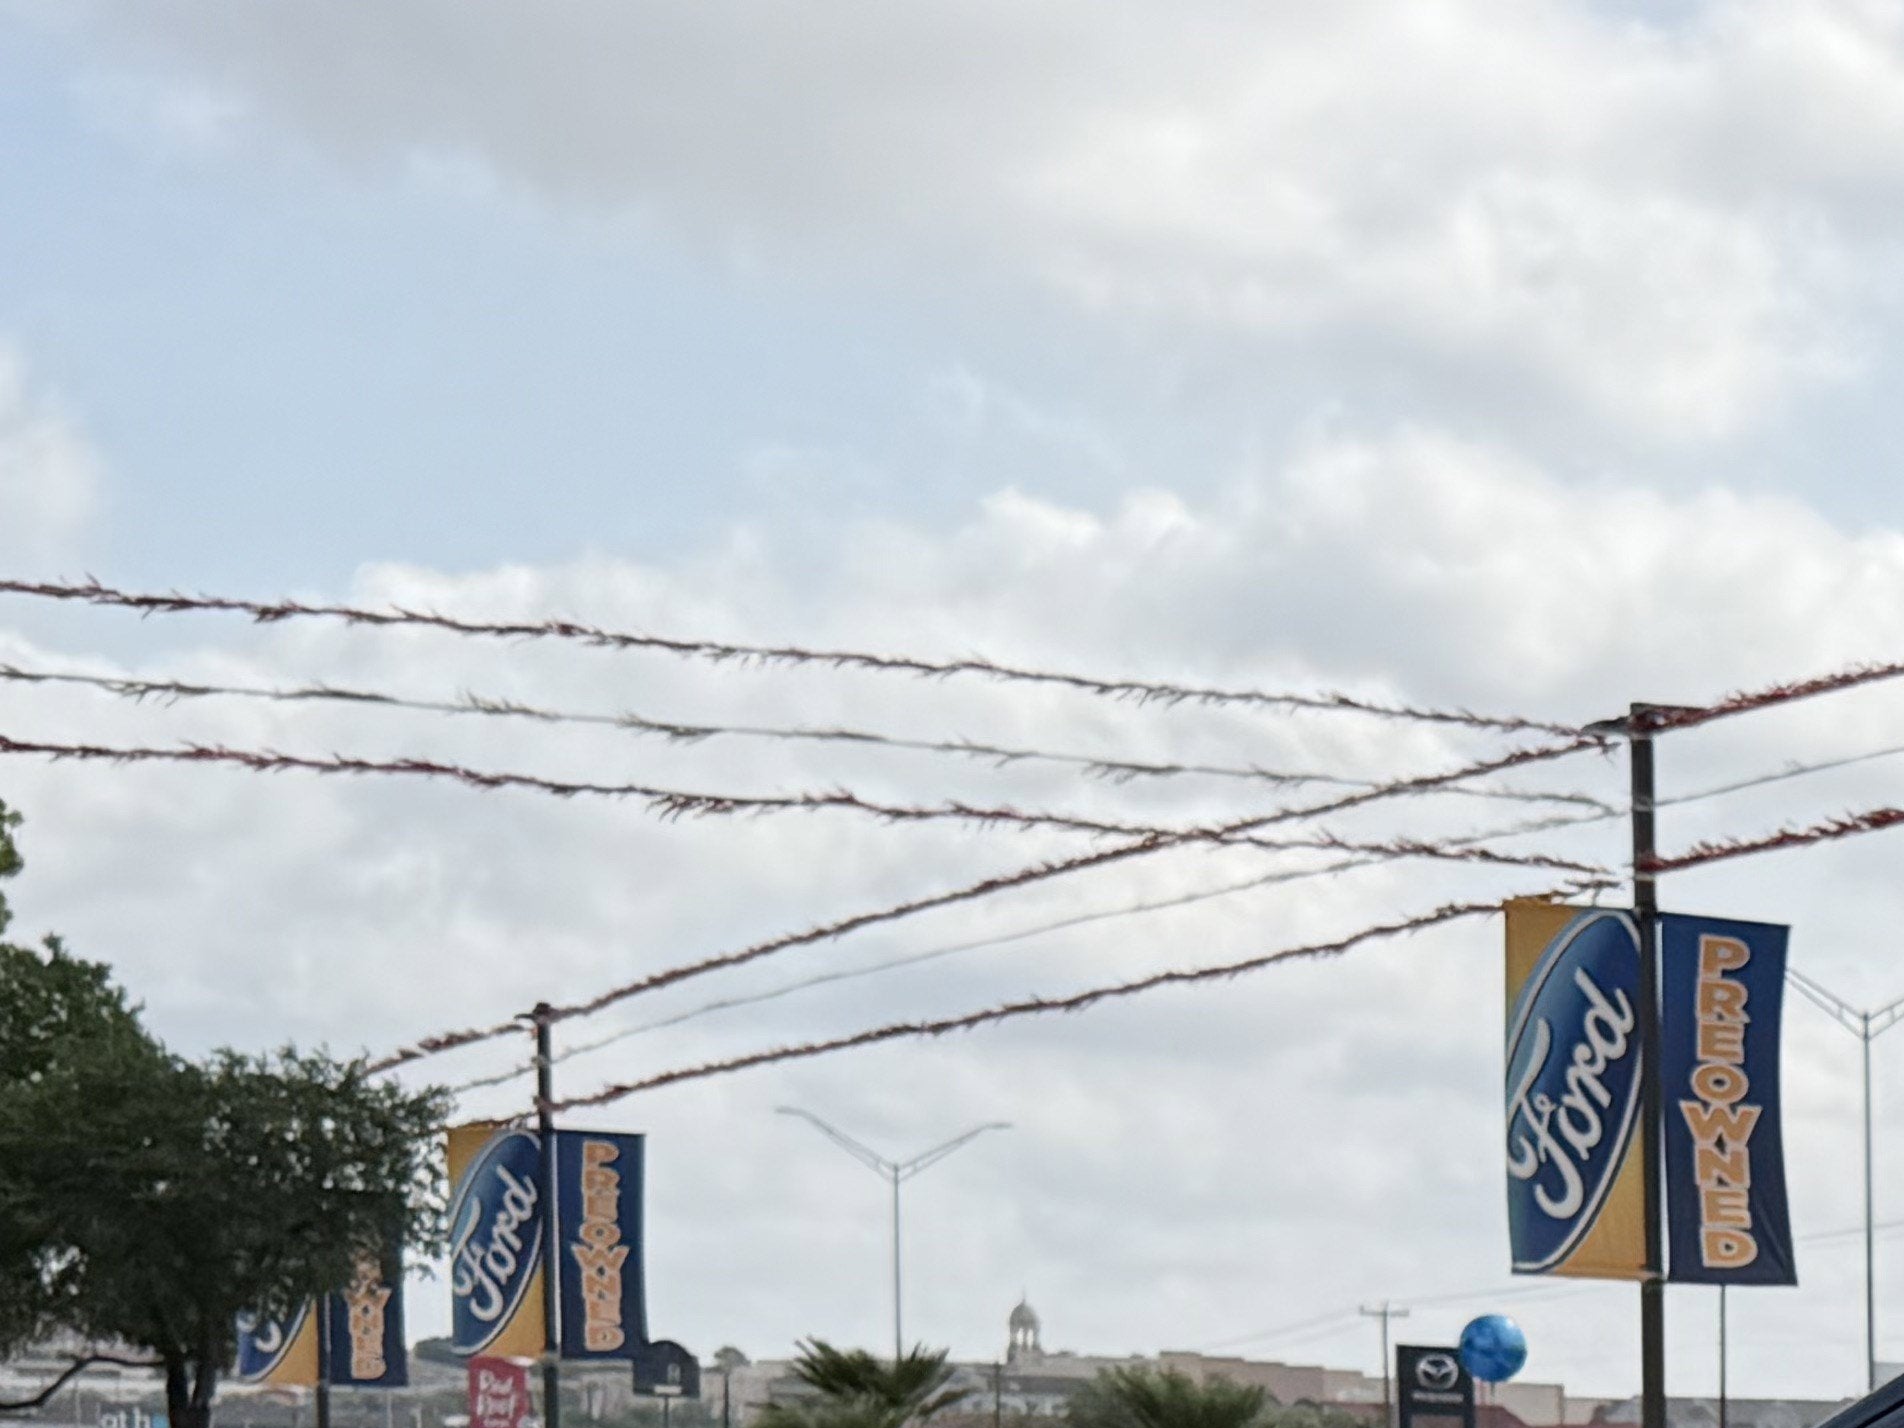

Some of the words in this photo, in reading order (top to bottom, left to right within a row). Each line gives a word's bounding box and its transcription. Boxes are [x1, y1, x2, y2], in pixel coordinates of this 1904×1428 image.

[1506, 966, 1635, 1220] Ford
[1678, 934, 1763, 1268] PREOWNED
[452, 1164, 538, 1322] Ford
